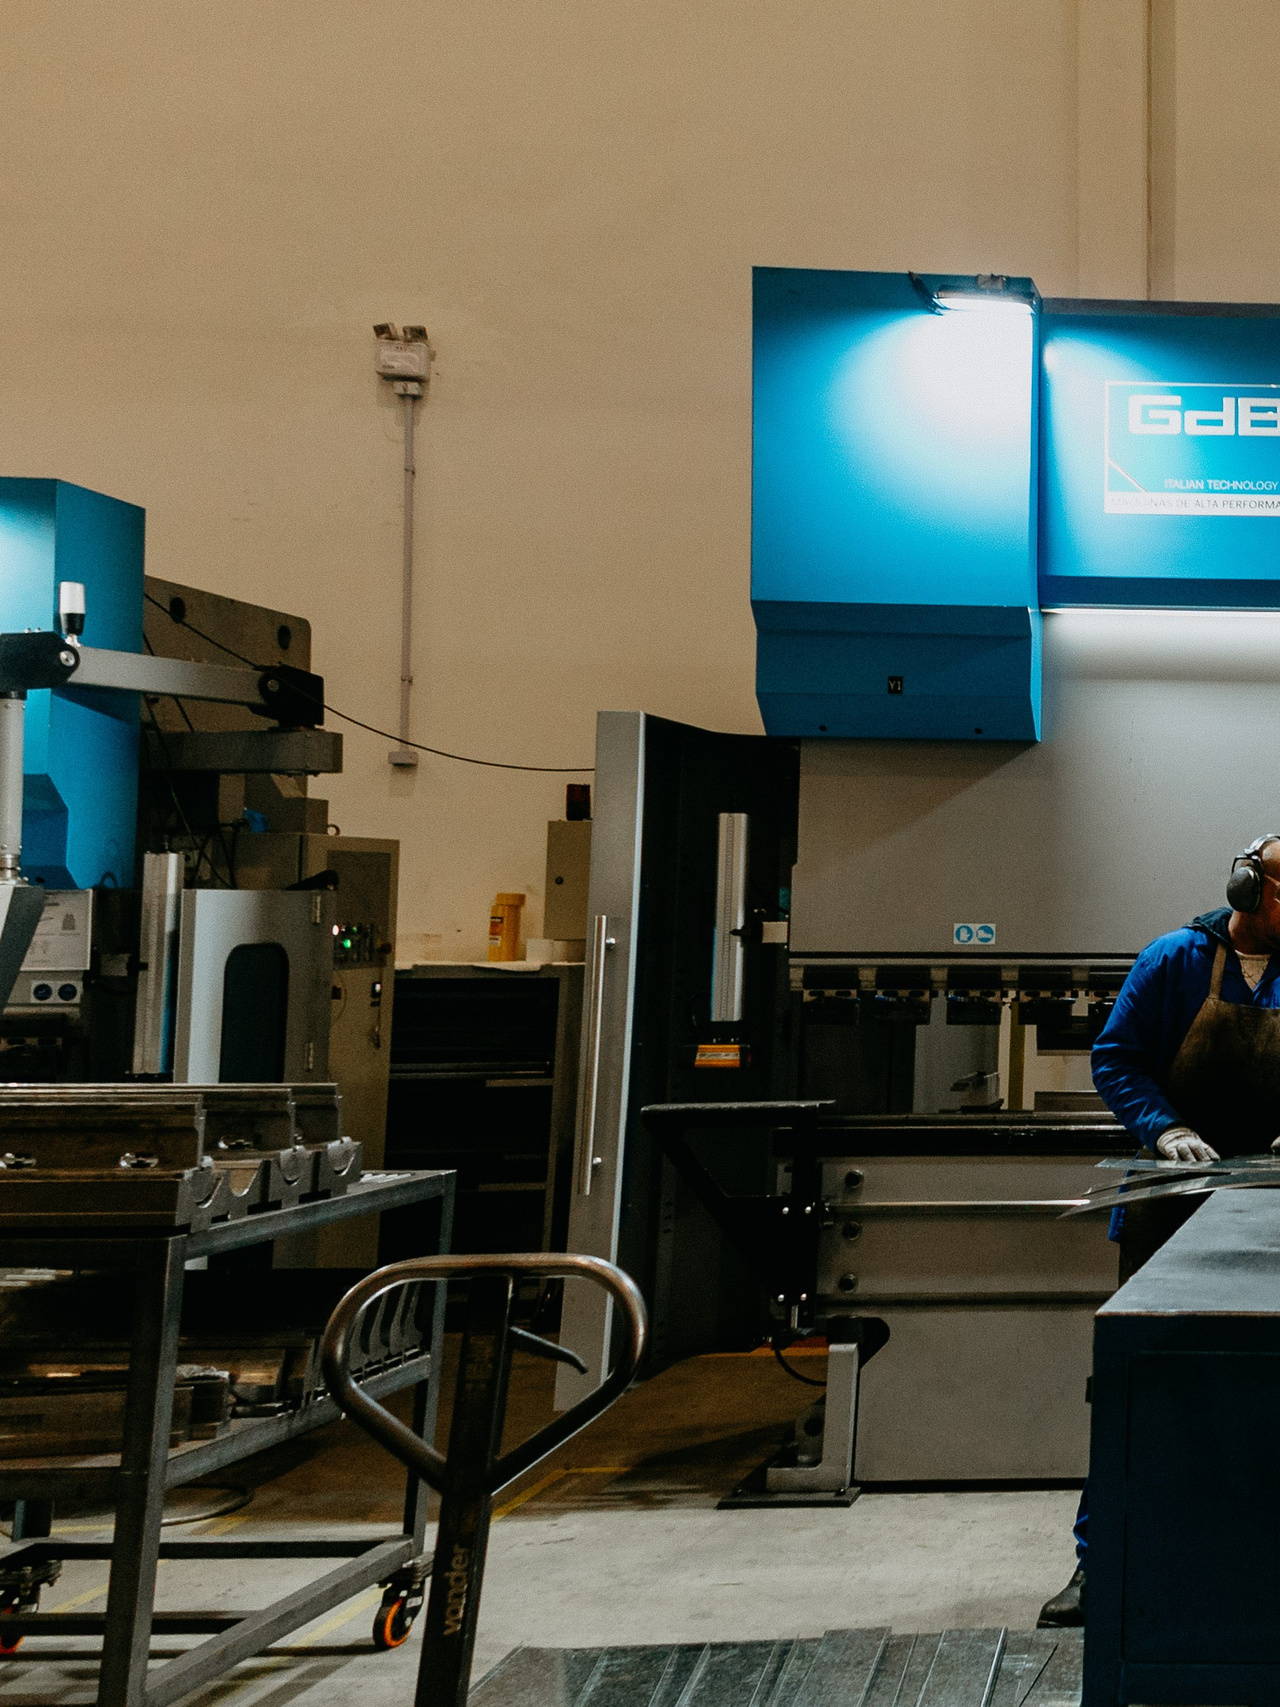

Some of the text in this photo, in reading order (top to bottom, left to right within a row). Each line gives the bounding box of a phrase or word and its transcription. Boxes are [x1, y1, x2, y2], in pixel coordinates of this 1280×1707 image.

[1164, 478, 1279, 491] ITALIAN TECHNOLOGY
[1176, 499, 1189, 508] DE
[1195, 499, 1219, 508] ALTA
[888, 680, 902, 691] Y1
